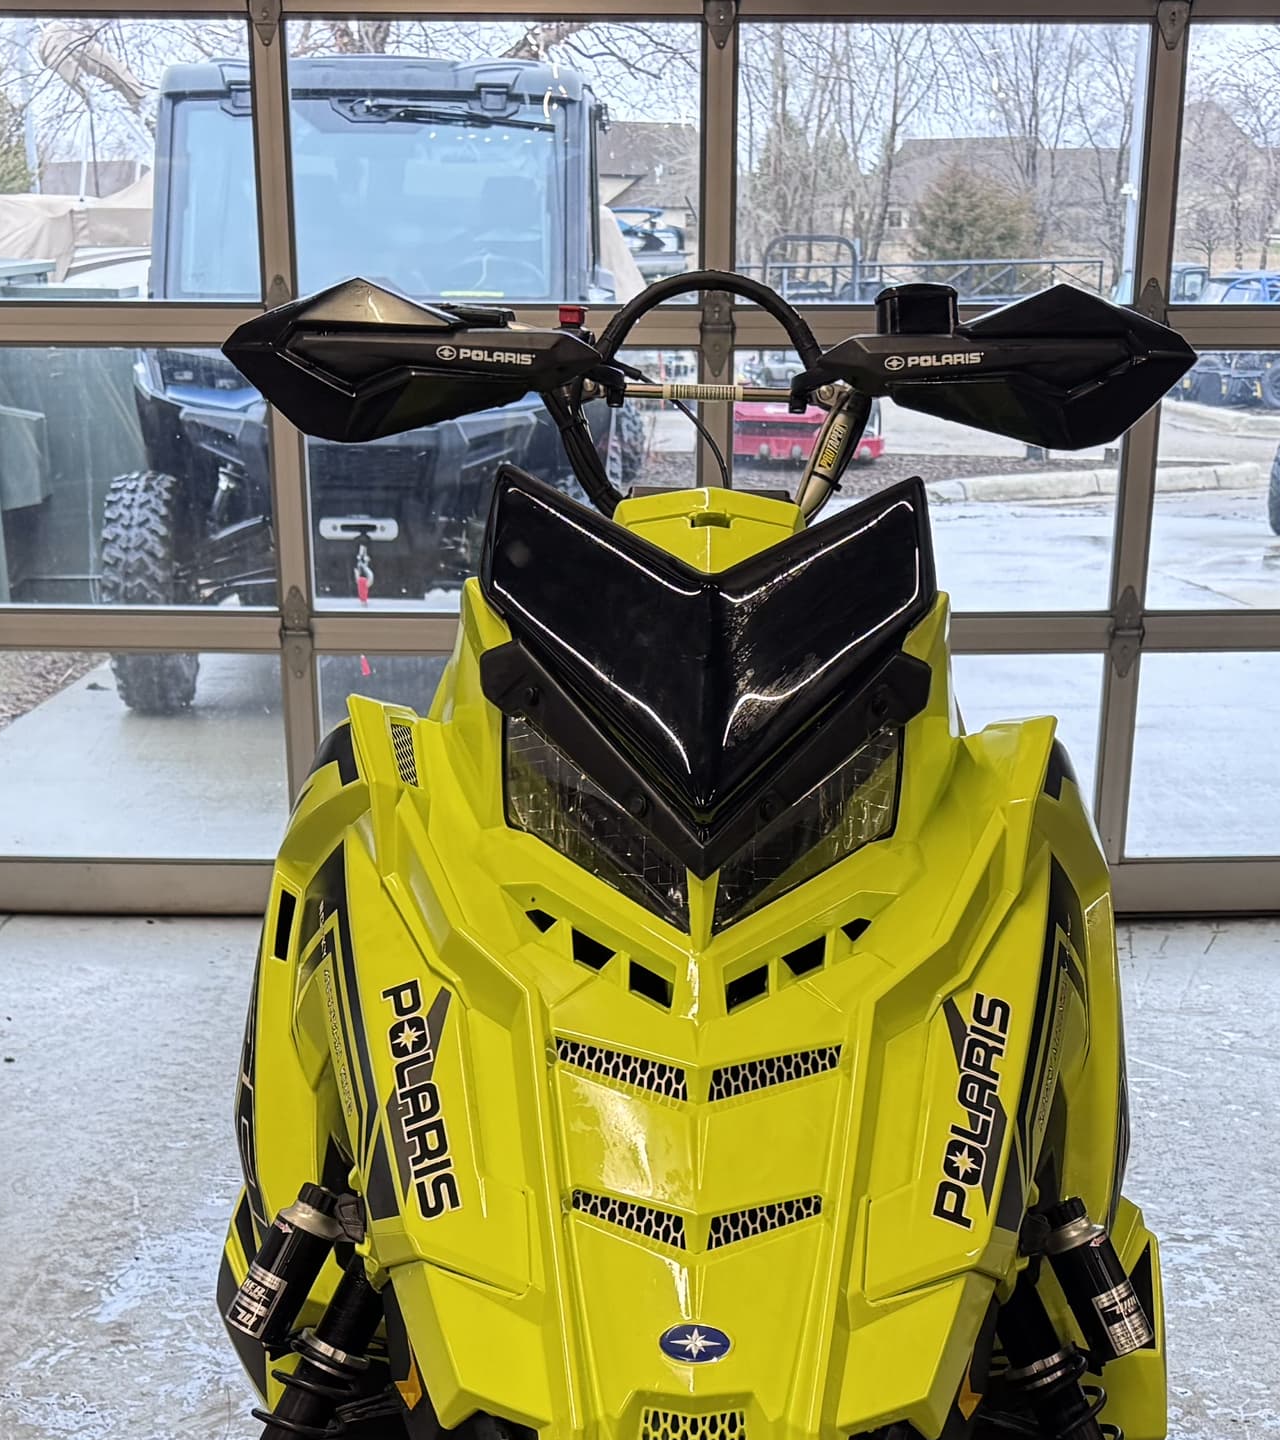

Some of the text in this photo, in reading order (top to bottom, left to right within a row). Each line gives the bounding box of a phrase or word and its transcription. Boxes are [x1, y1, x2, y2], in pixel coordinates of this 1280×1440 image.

[459, 348, 533, 365] POLARIS
[907, 352, 982, 367] POLARIS
[381, 979, 463, 1222] POLARIS
[931, 991, 1012, 1231] POLARIS
